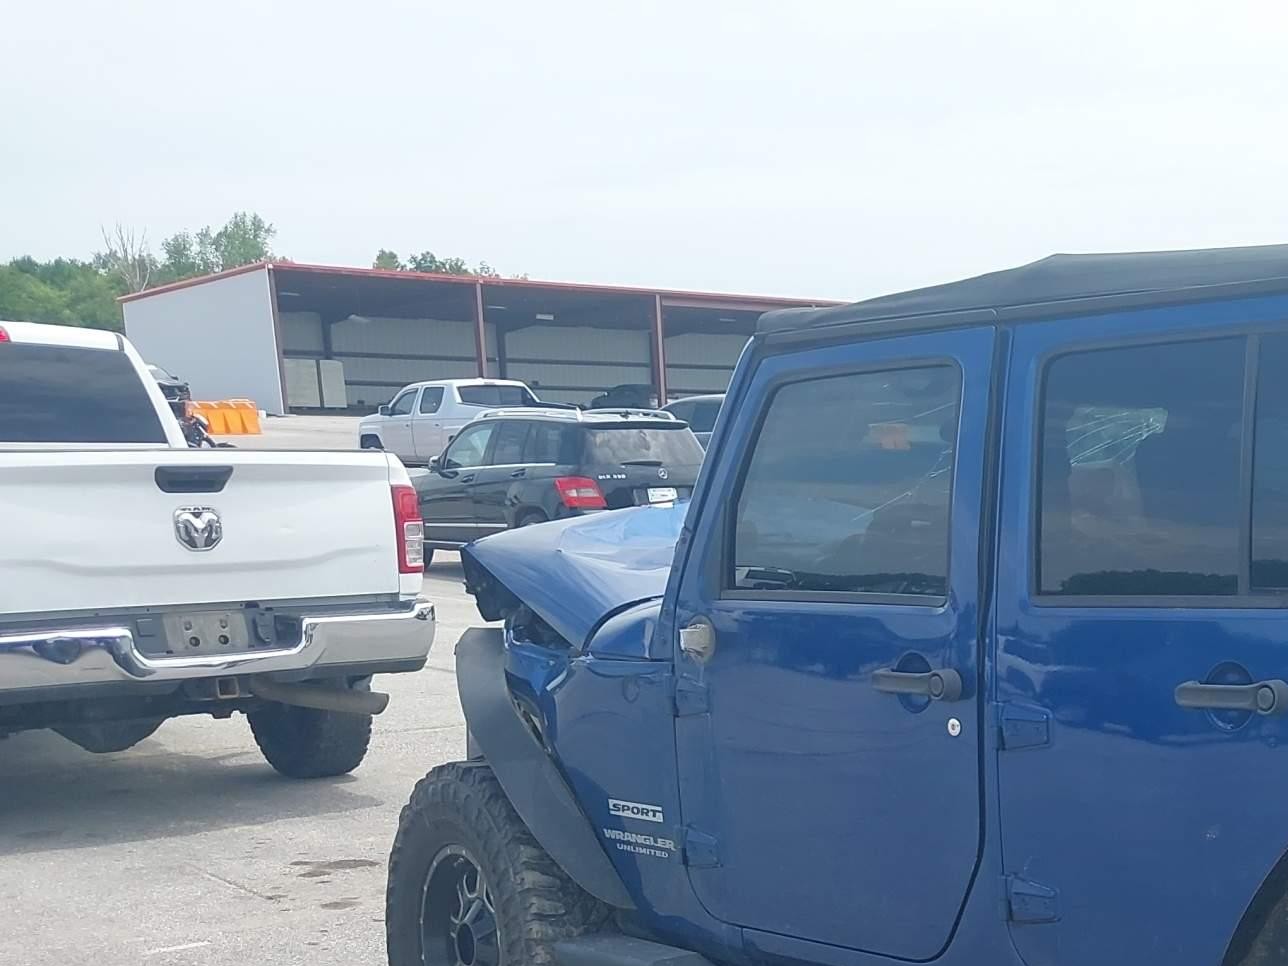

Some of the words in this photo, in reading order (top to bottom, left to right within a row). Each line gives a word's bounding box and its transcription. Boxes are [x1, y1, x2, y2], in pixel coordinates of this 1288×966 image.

[612, 803, 662, 818] SPORT
[603, 828, 677, 851] WRANGLER
[616, 843, 668, 858] UNLIMITED
